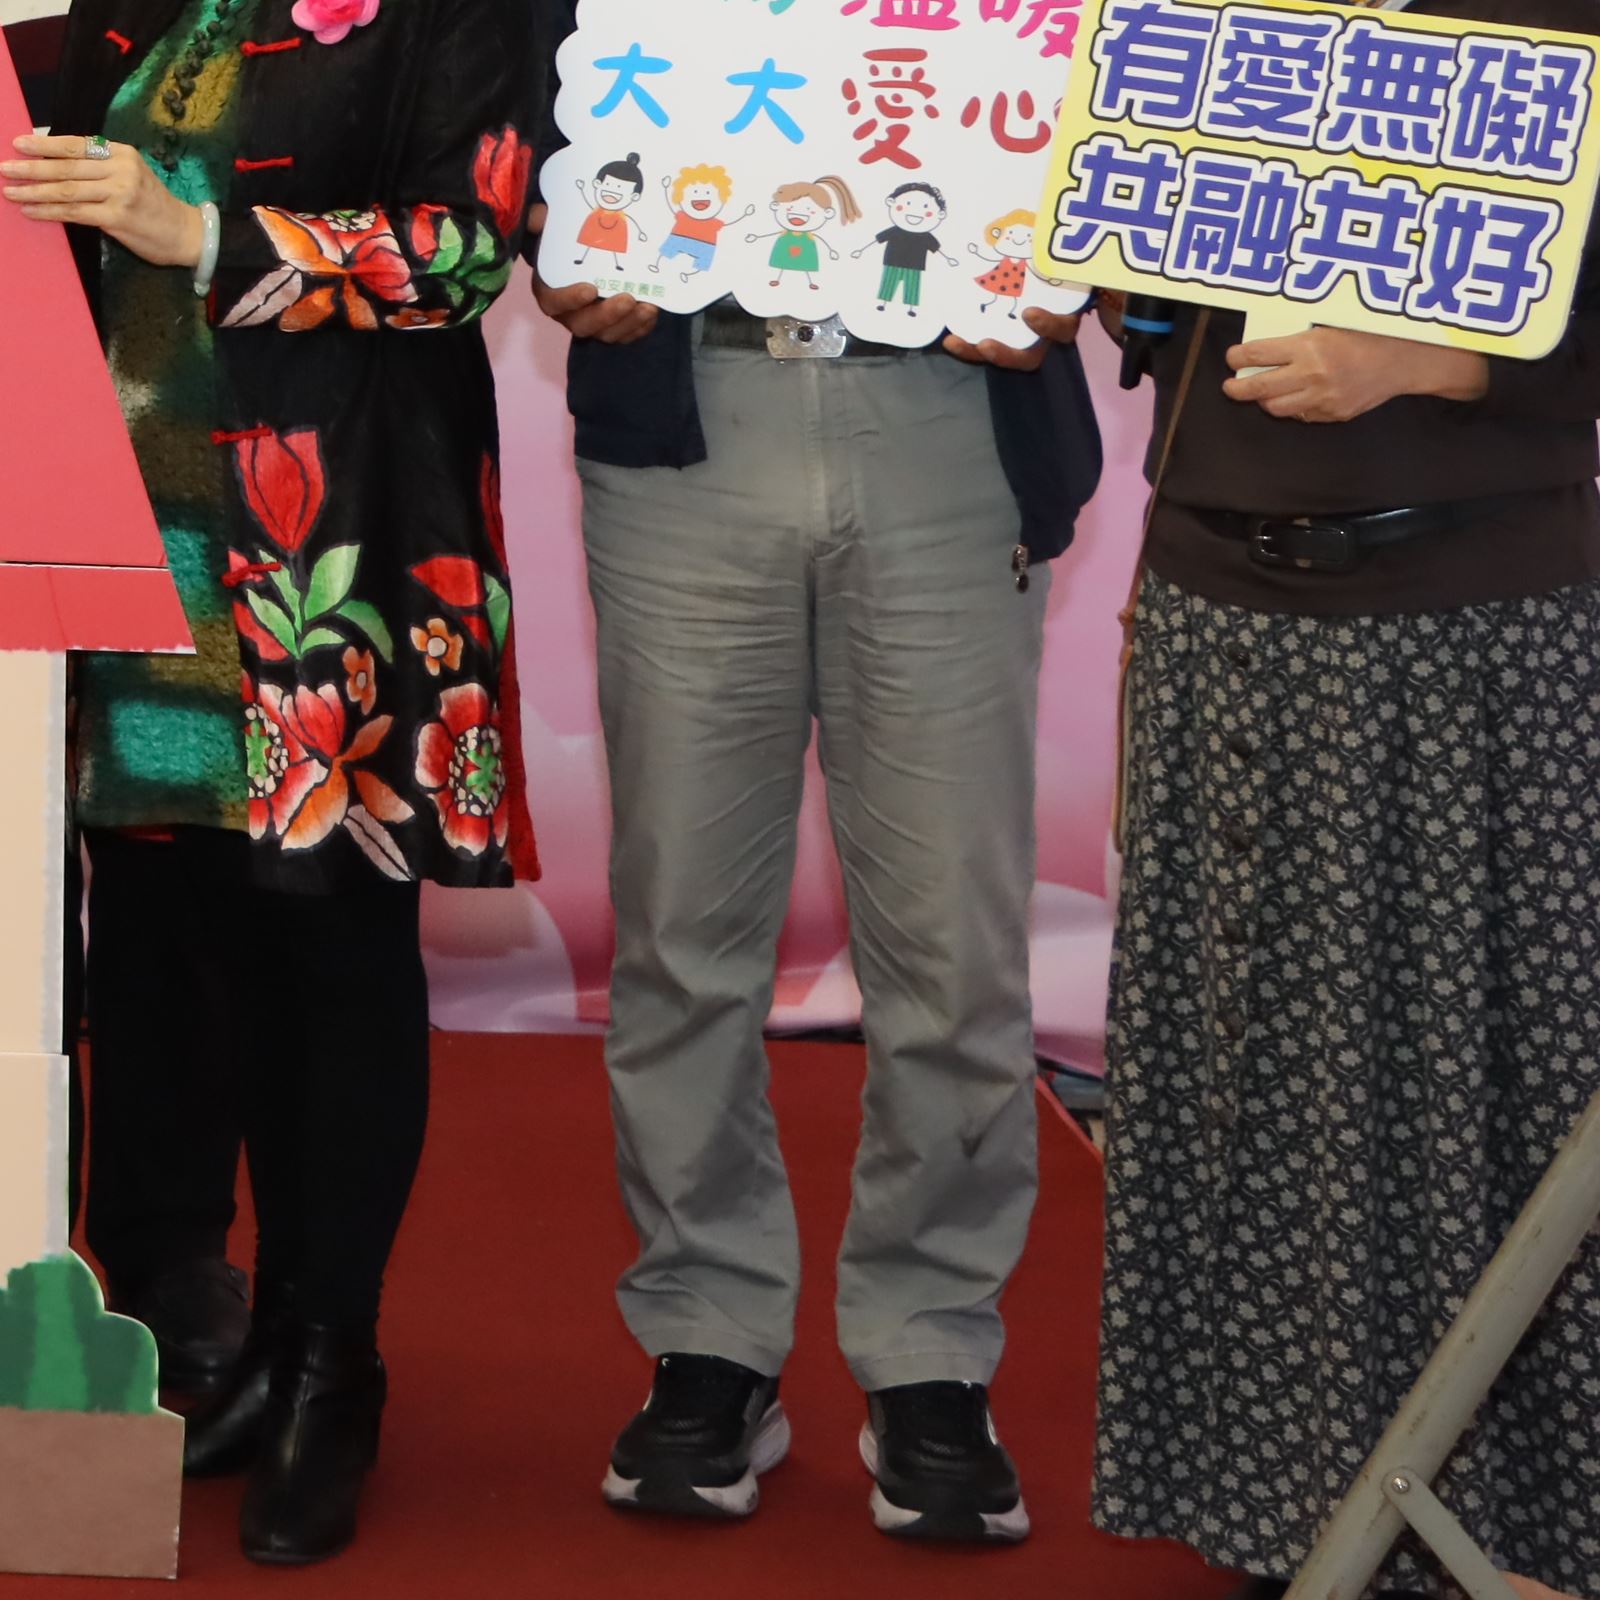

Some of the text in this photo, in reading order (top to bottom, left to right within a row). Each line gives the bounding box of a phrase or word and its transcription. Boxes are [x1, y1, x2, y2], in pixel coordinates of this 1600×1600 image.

[590, 42, 1062, 169] 大大愛心
[1097, 0, 1583, 176] 有愛無礙
[1059, 140, 1551, 326] 共融共好
